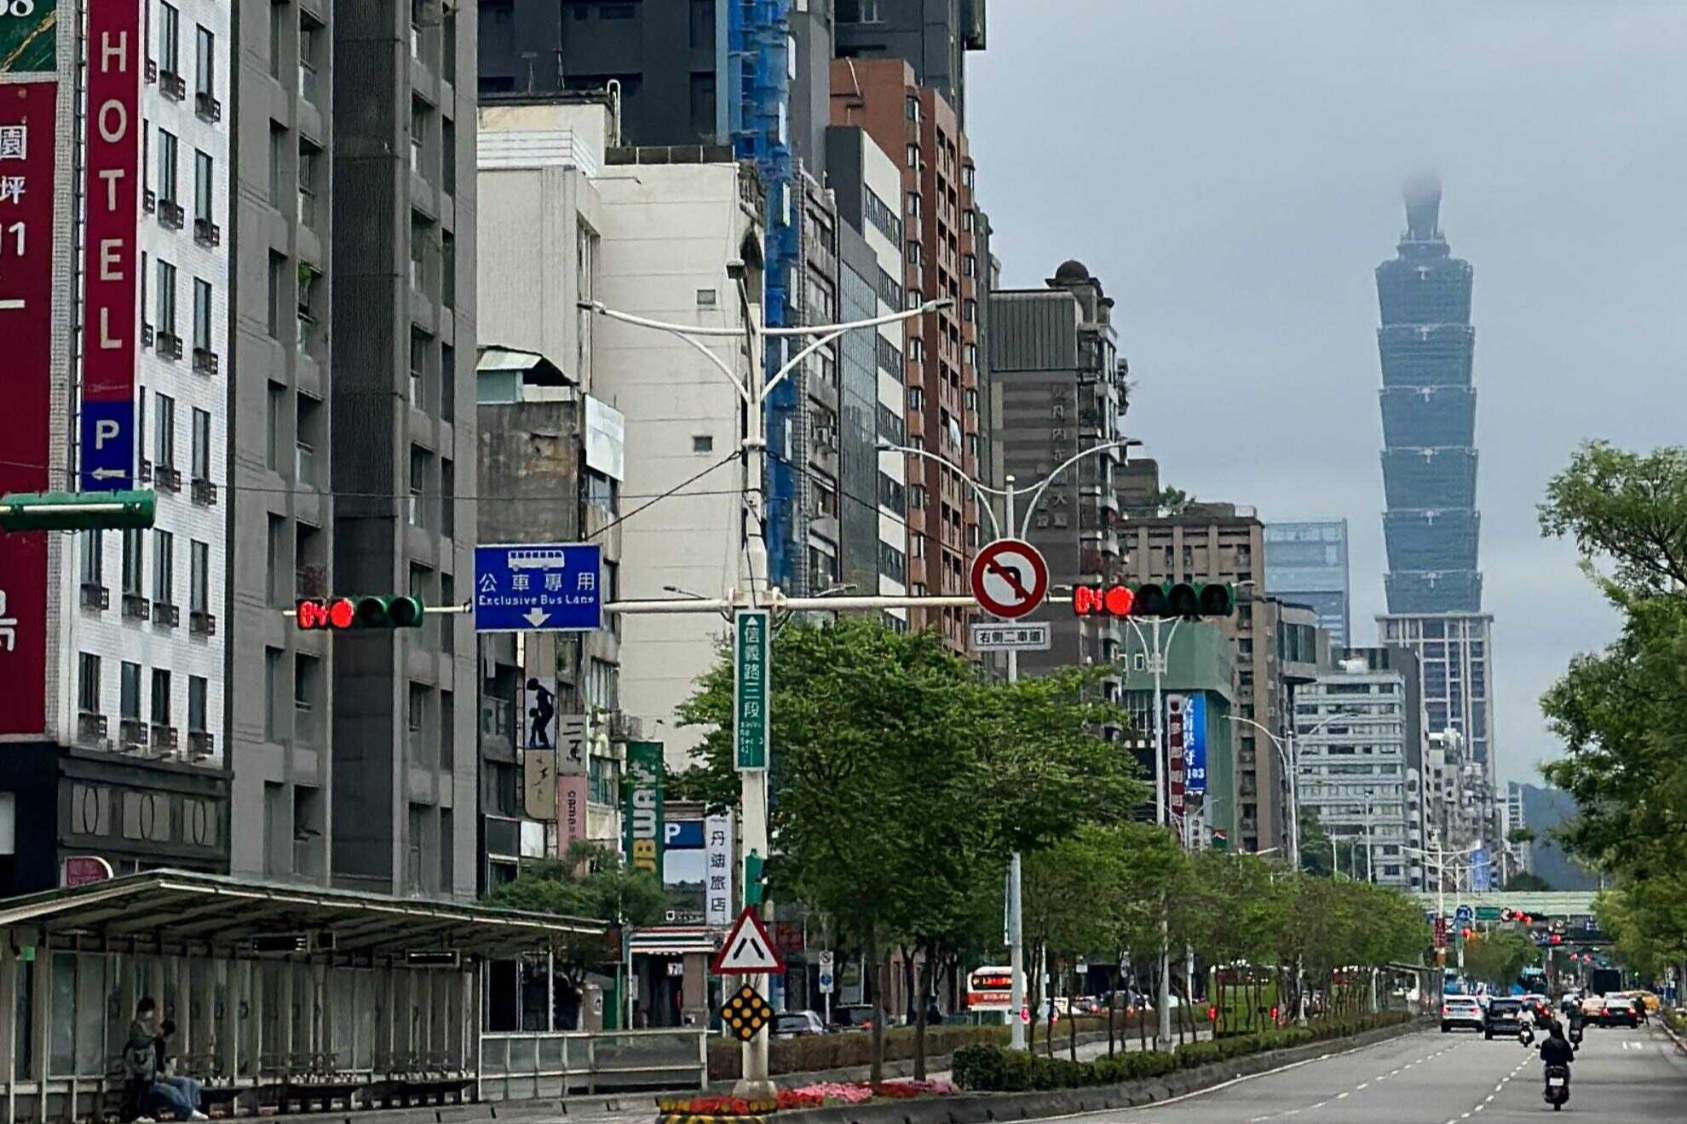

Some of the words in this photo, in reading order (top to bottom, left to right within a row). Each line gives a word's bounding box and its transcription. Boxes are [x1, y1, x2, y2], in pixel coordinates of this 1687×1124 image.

[98, 31, 127, 349] HOTEL
[95, 419, 119, 450] P
[478, 595, 537, 606] Exclusive
[540, 594, 563, 605] Bus
[565, 595, 595, 605] Lane
[479, 572, 595, 593] 公車專用
[744, 627, 760, 718] 信義路三段
[631, 761, 657, 873] UBWAY
[664, 823, 681, 845] P
[710, 830, 727, 912] 丹迪旅店
